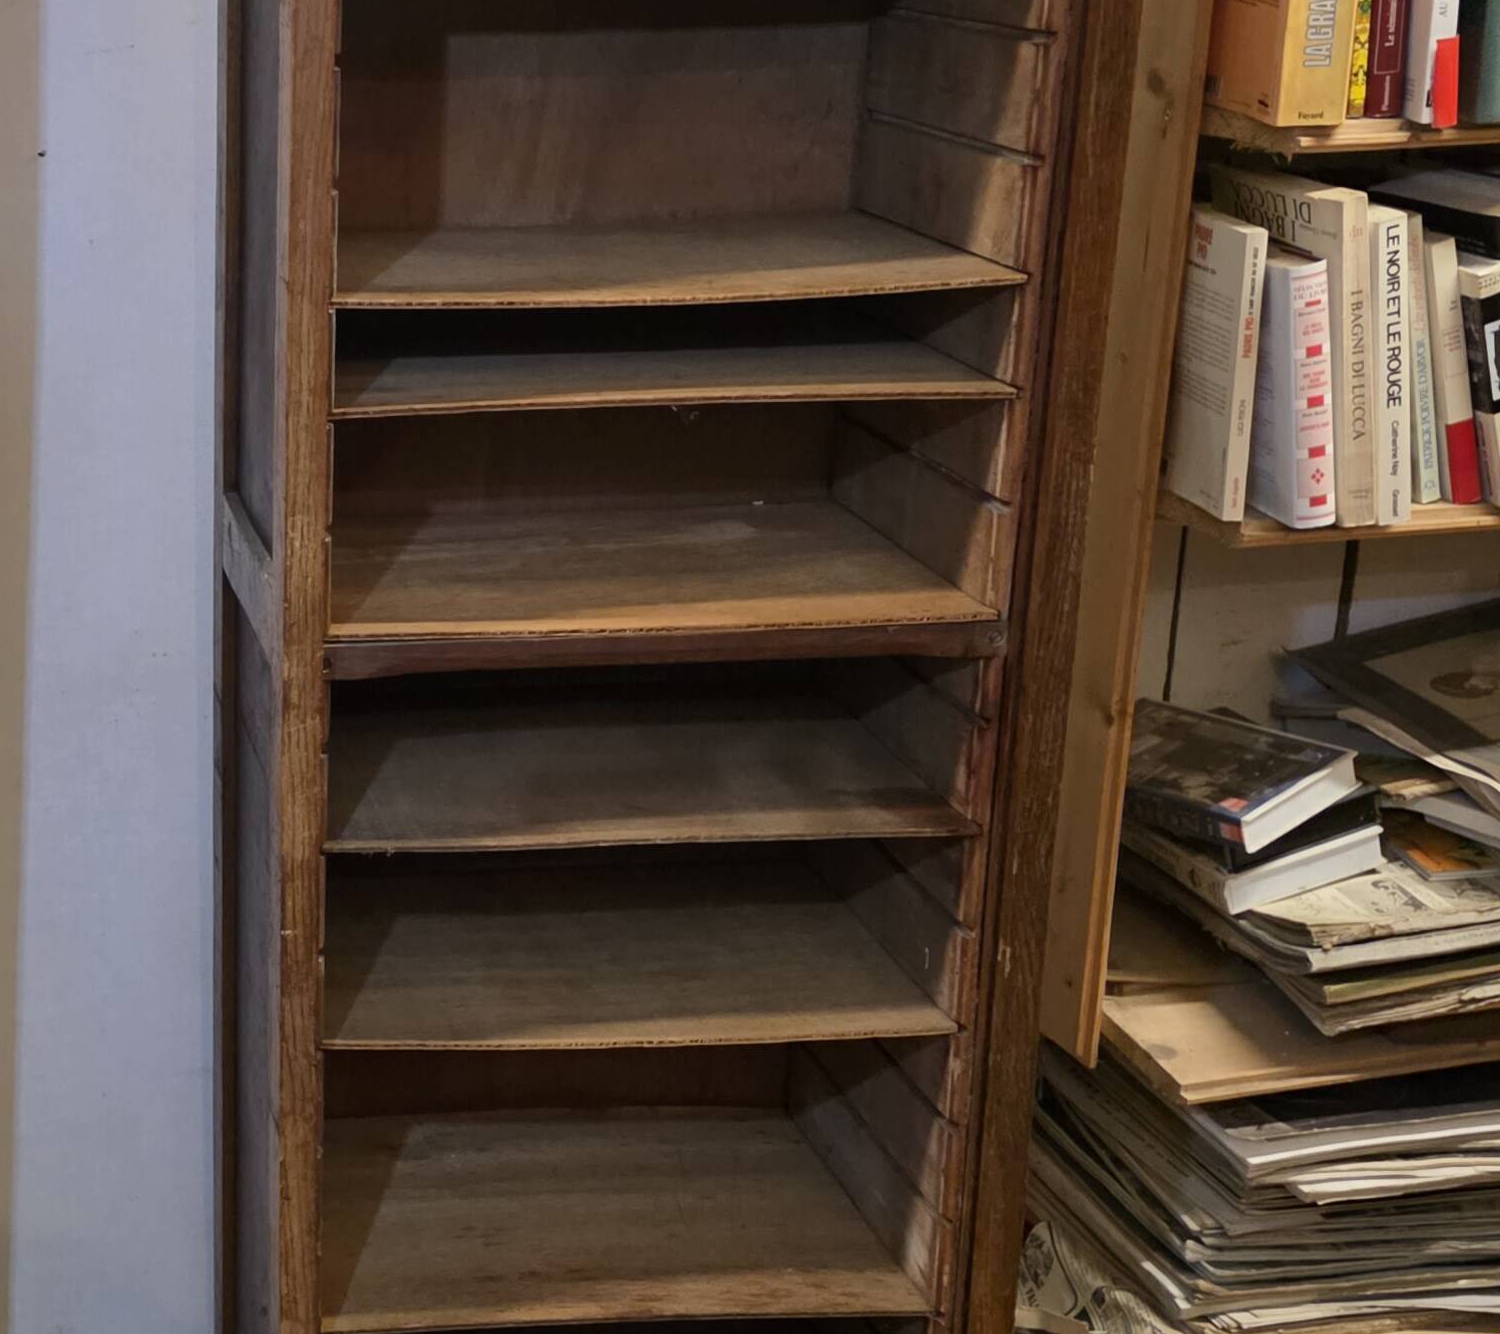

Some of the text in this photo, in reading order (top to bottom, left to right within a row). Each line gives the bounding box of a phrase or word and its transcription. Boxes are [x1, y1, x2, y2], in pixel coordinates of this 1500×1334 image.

[1438, 2, 1449, 18] AU
[1302, 44, 1332, 68] LA
[1293, 199, 1311, 225] DI
[1350, 300, 1365, 354] BAGNI
[1386, 224, 1402, 410] LE NOIR ET LE ROUGE
[1352, 360, 1365, 378] DI
[1352, 385, 1367, 441] LUCCA
[1391, 420, 1400, 459] Catherine
